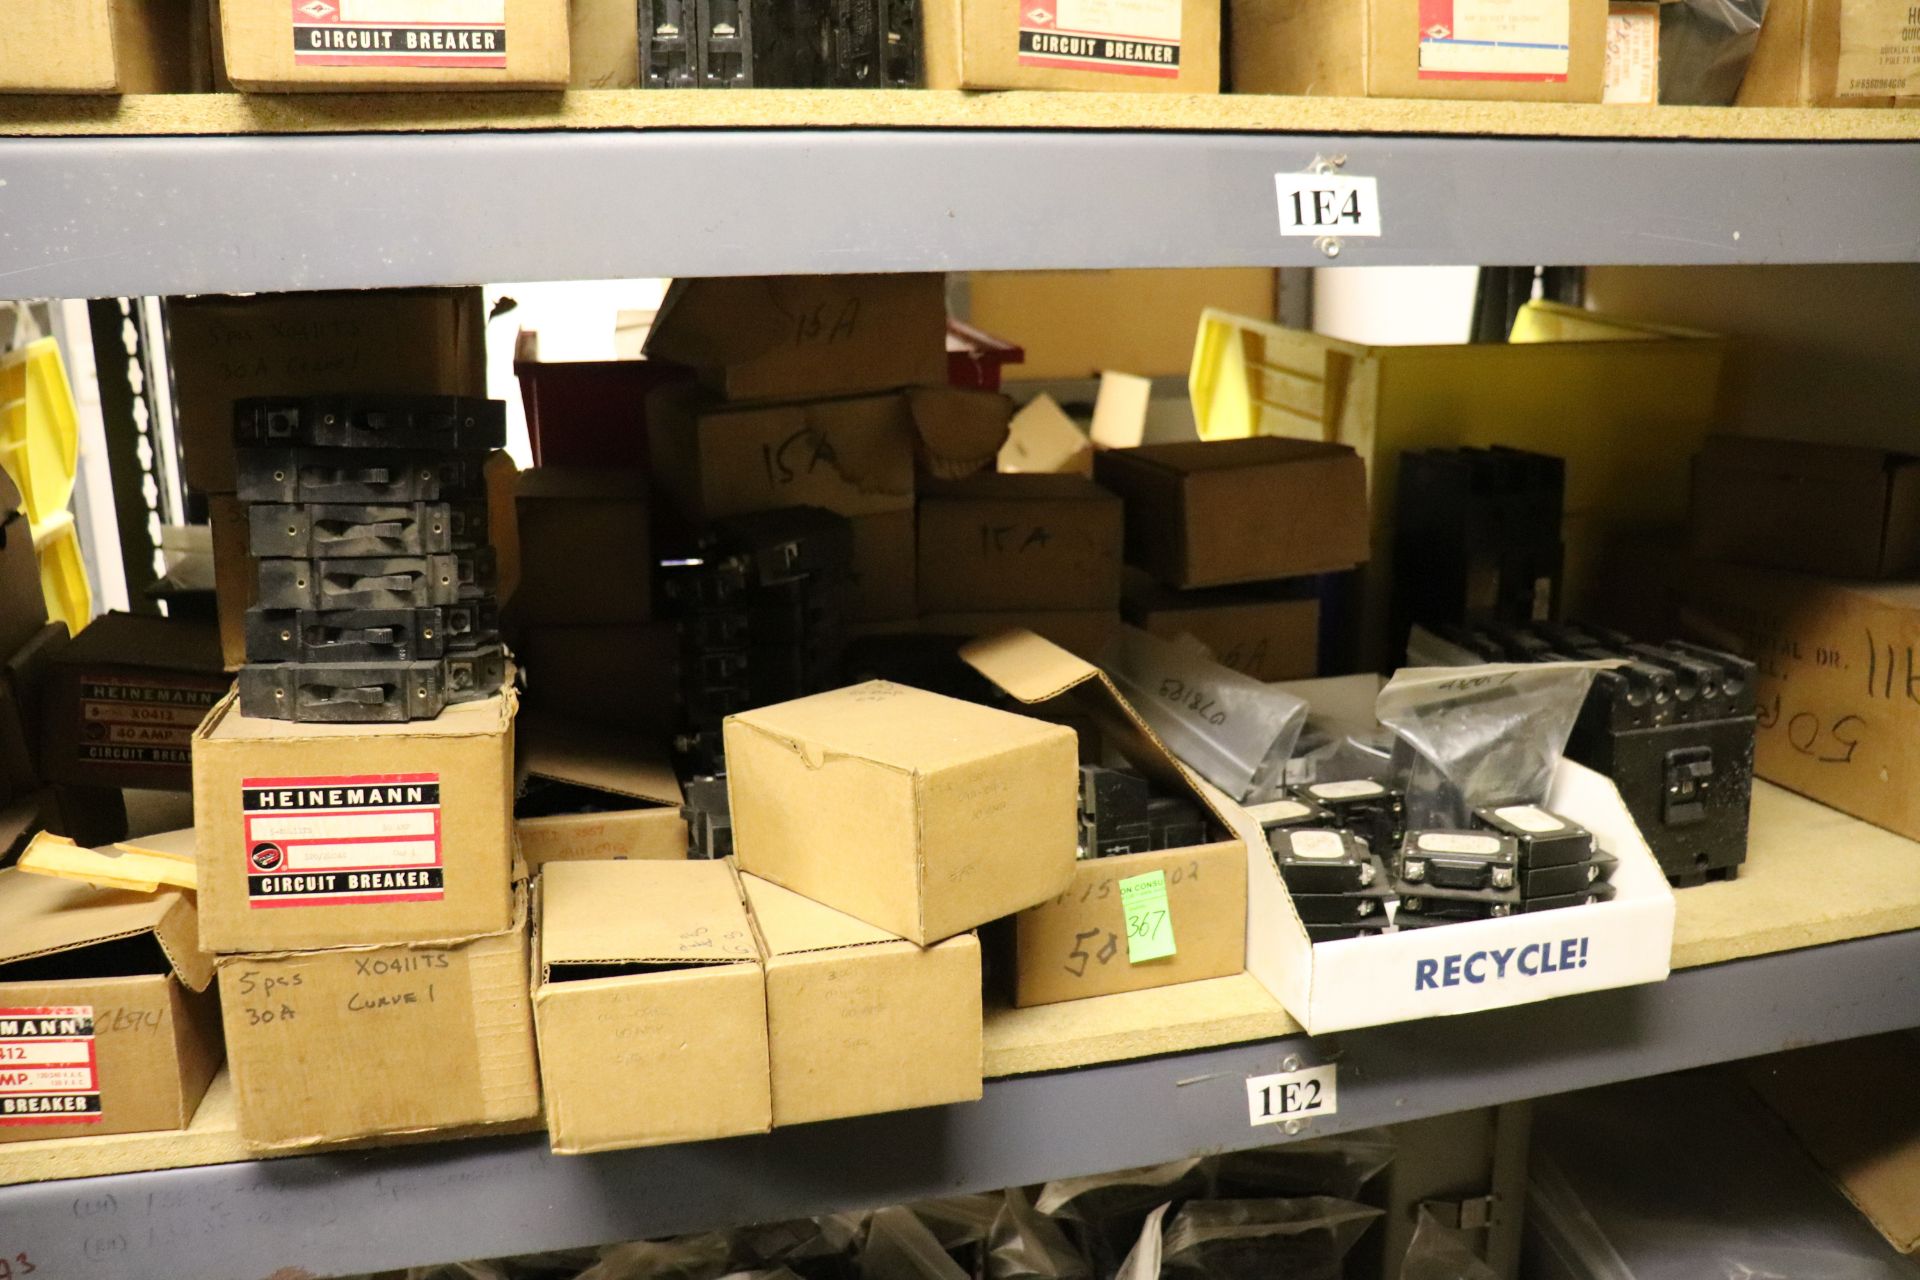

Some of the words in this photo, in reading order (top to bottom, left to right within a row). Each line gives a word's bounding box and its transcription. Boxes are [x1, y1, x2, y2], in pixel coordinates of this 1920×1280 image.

[310, 30, 393, 49] CIRCUIT
[406, 31, 495, 50] BREAKER
[1031, 34, 1096, 56] CIRCUIT
[1104, 41, 1173, 63] BREAKER
[1289, 189, 1361, 225] 1E4
[93, 685, 213, 704] HEINEMANN
[139, 727, 174, 740] AMP
[89, 745, 144, 760] CIRCUIT
[259, 787, 423, 808] HEINEMANN
[261, 875, 336, 894] CIRCUIT
[348, 870, 431, 890] BREAKER
[1127, 909, 1167, 942] 367
[1414, 936, 1590, 992] RECYCLE!
[238, 971, 260, 995] 5
[4, 1096, 87, 1113] BREAKER
[1259, 1079, 1323, 1117] 1E2
